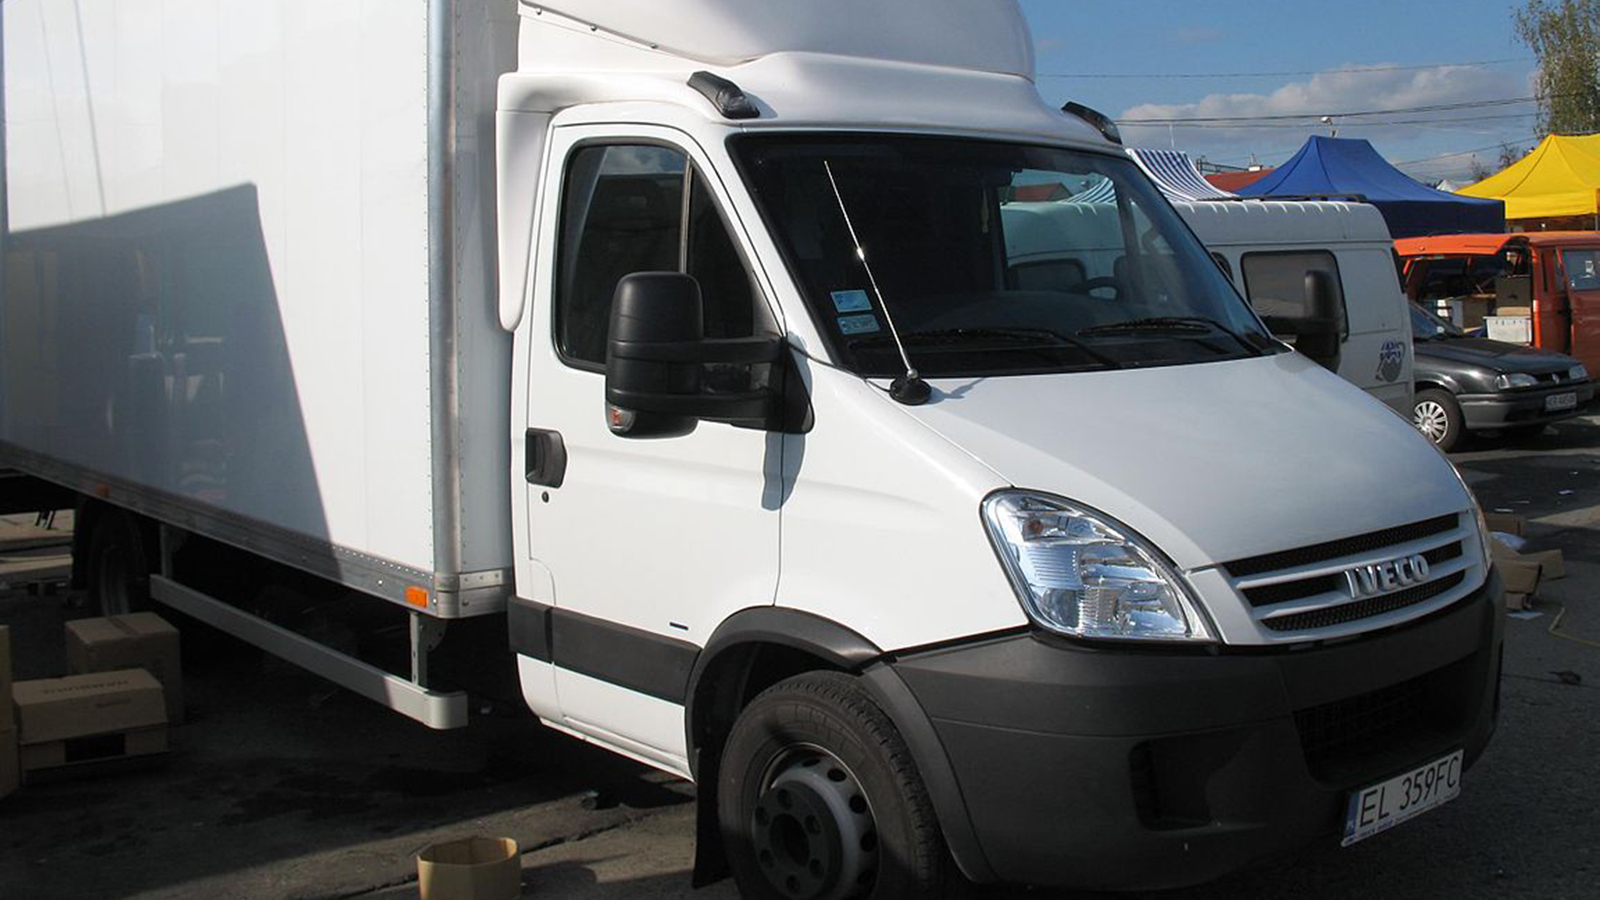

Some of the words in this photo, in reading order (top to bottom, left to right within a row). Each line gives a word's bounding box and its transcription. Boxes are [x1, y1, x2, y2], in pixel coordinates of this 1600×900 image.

[1344, 555, 1430, 599] IVECO
[1359, 786, 1389, 828] EL
[1399, 756, 1459, 810] 359FC
